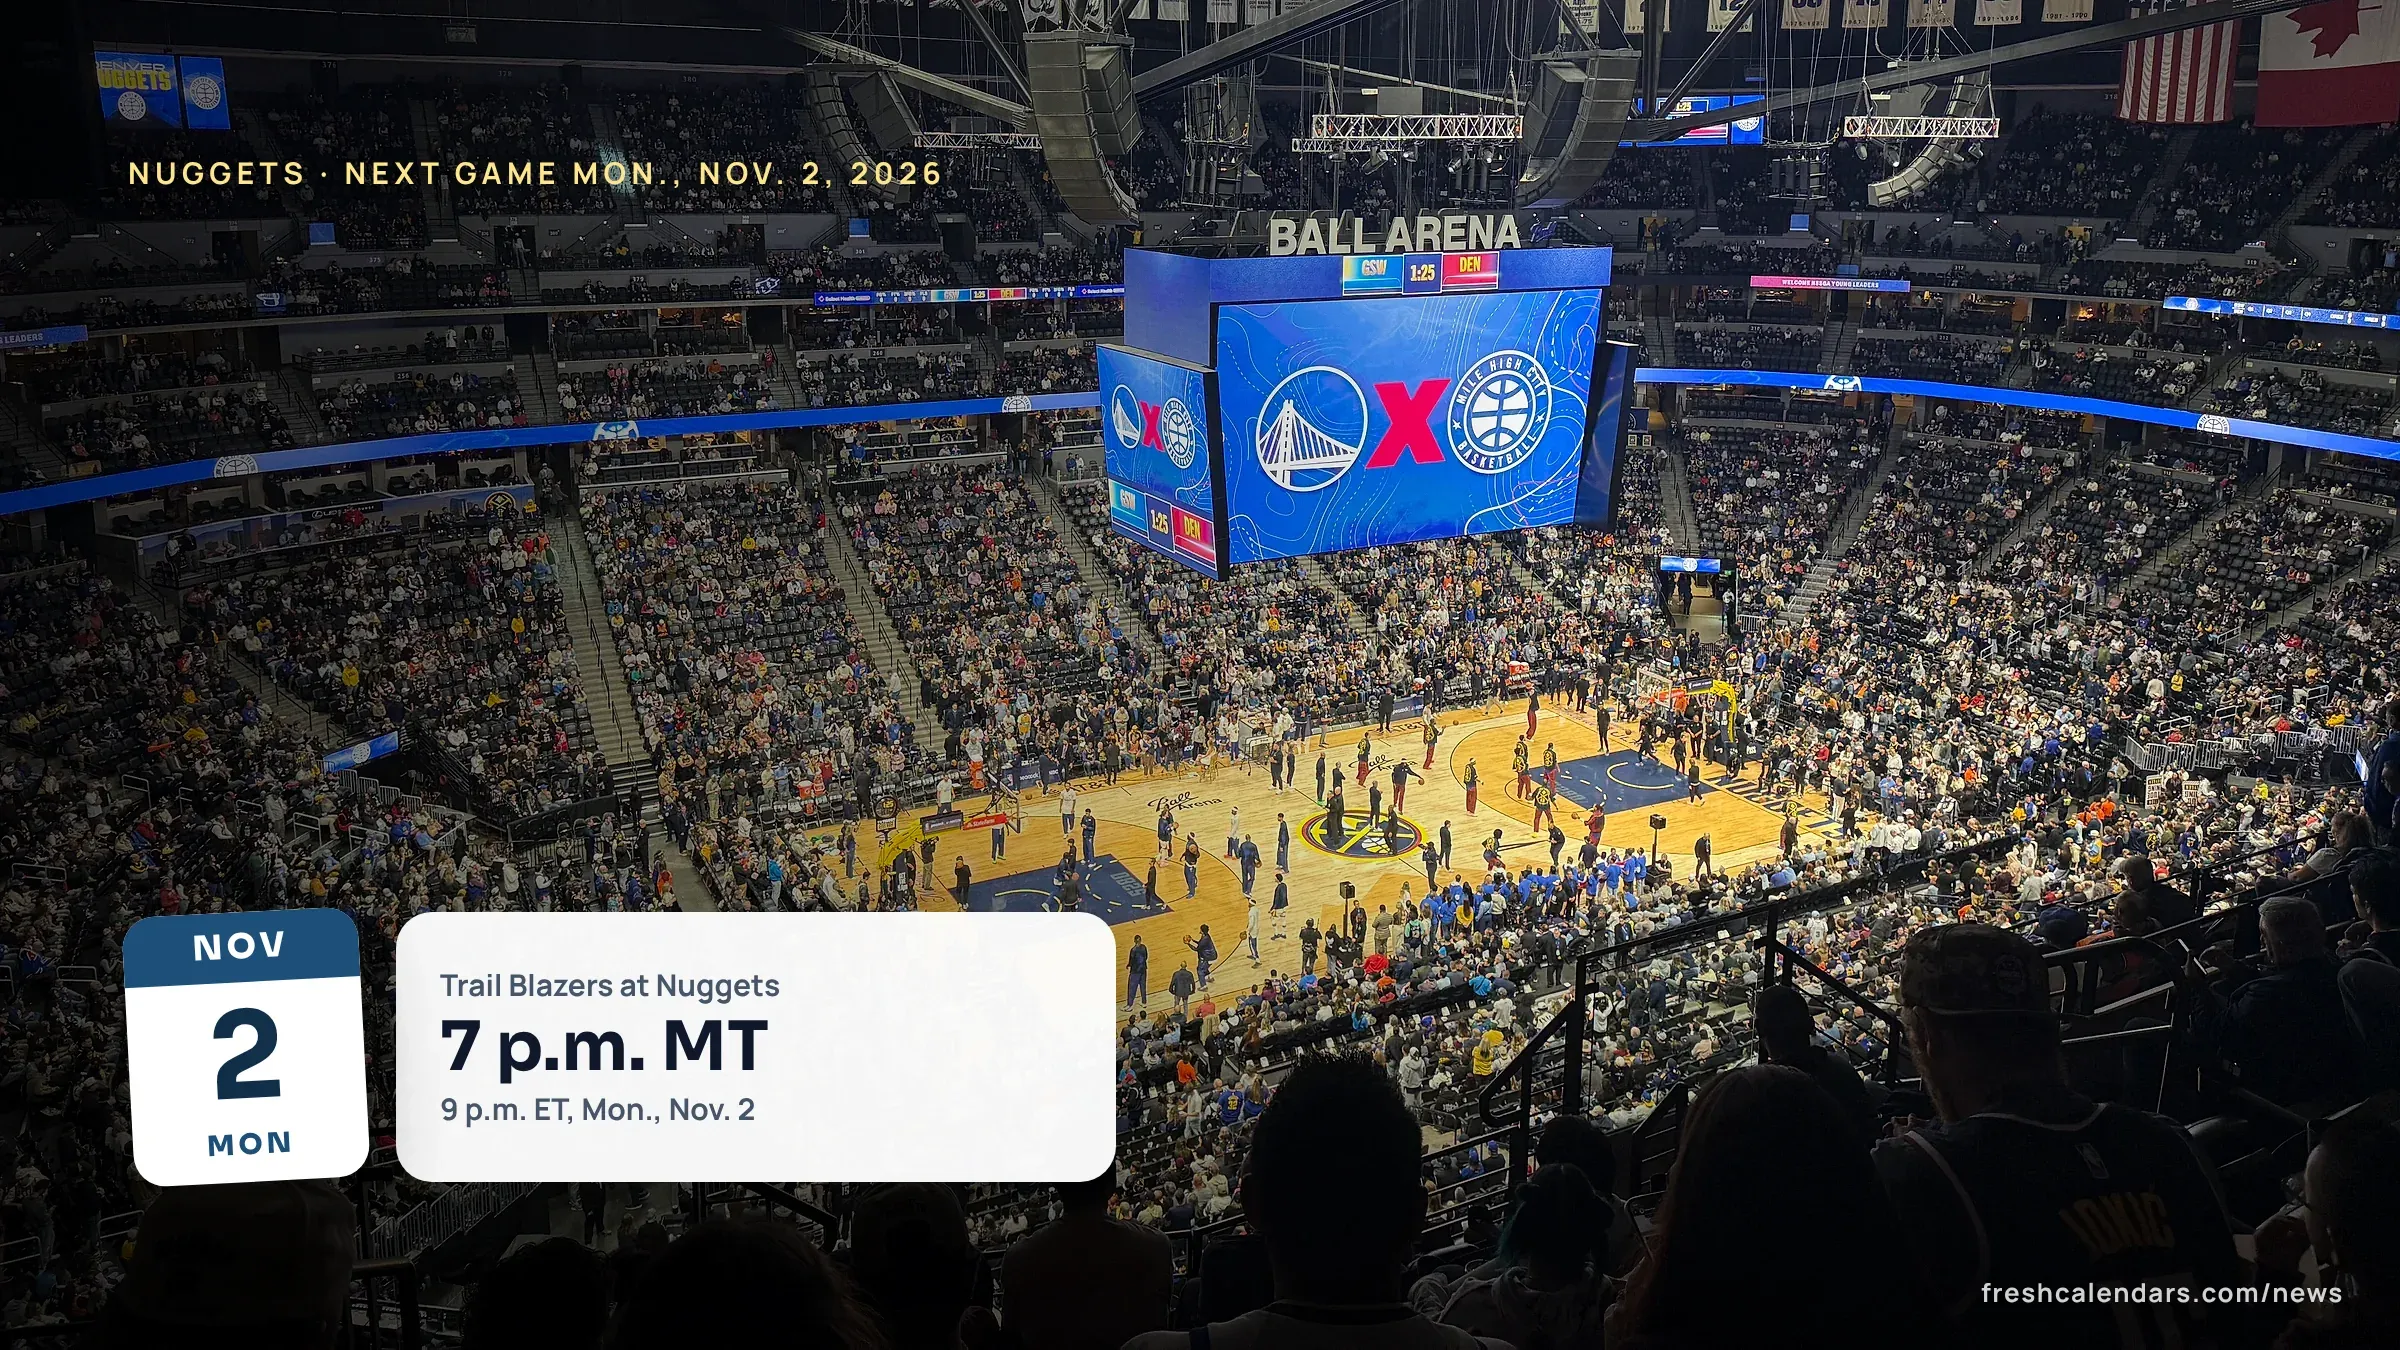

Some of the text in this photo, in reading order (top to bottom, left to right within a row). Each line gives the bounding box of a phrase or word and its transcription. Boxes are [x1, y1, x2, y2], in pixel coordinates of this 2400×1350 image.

[1269, 214, 1522, 257] BALL ARENA
[1361, 256, 1481, 282] GSW 1:25 DEN
[1001, 288, 1014, 299] DEN
[4, 333, 44, 344] LEADERS
[1455, 356, 1548, 406] MILE HIGH CITY
[1457, 434, 1537, 469] BASKETBALL
[1119, 488, 1201, 541] GSW 1:25 DEN
